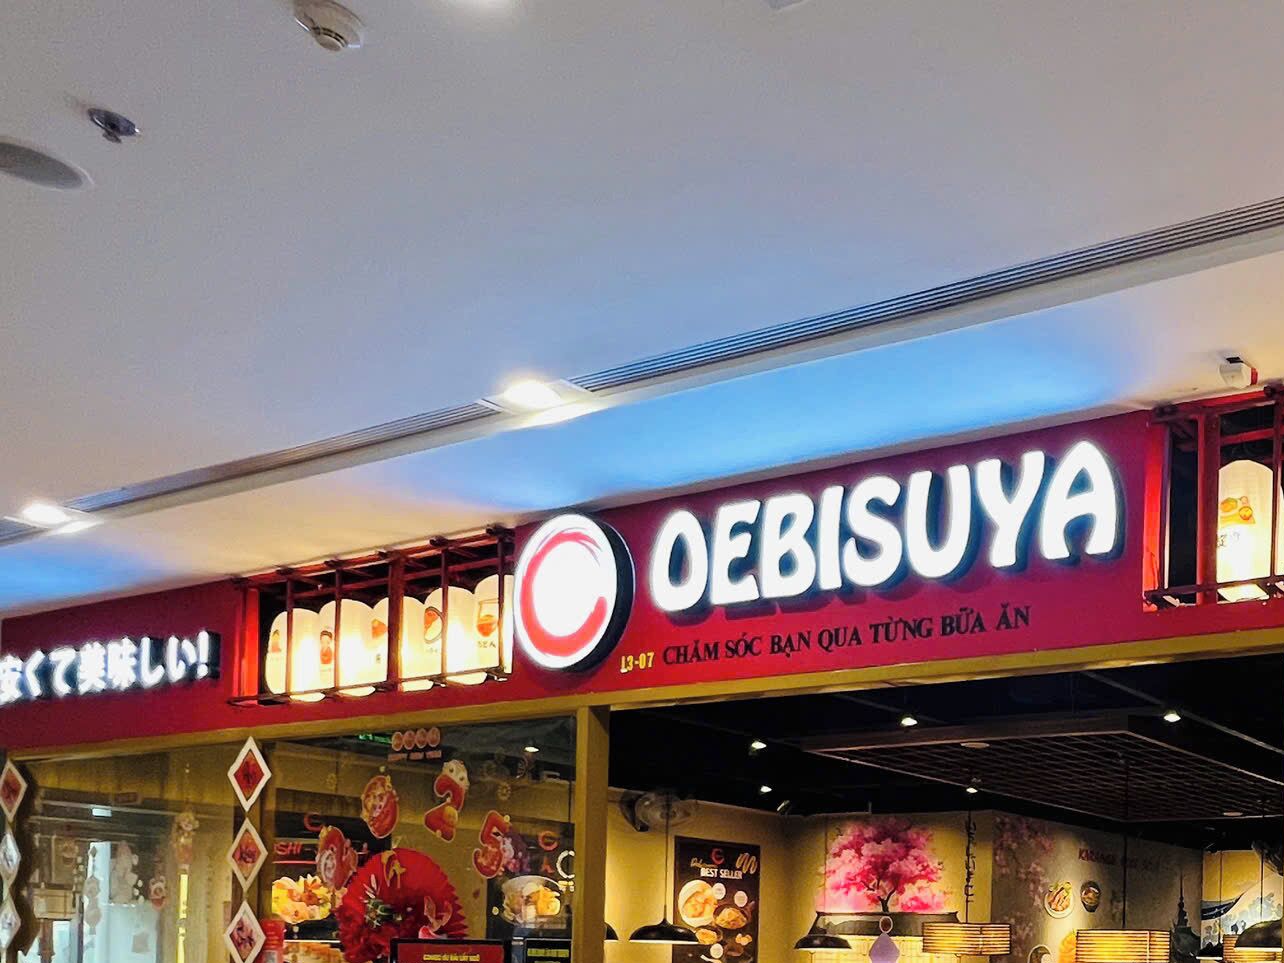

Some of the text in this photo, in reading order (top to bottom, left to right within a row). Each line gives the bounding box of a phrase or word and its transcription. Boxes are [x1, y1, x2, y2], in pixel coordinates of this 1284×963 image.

[648, 439, 1119, 612] OEBISUYA
[724, 631, 762, 660] SÓC
[769, 630, 812, 658] BẠN
[817, 626, 863, 652] QUA
[869, 615, 934, 644] TỪNG
[940, 607, 986, 637] BỮA
[995, 602, 1031, 631] ĂN
